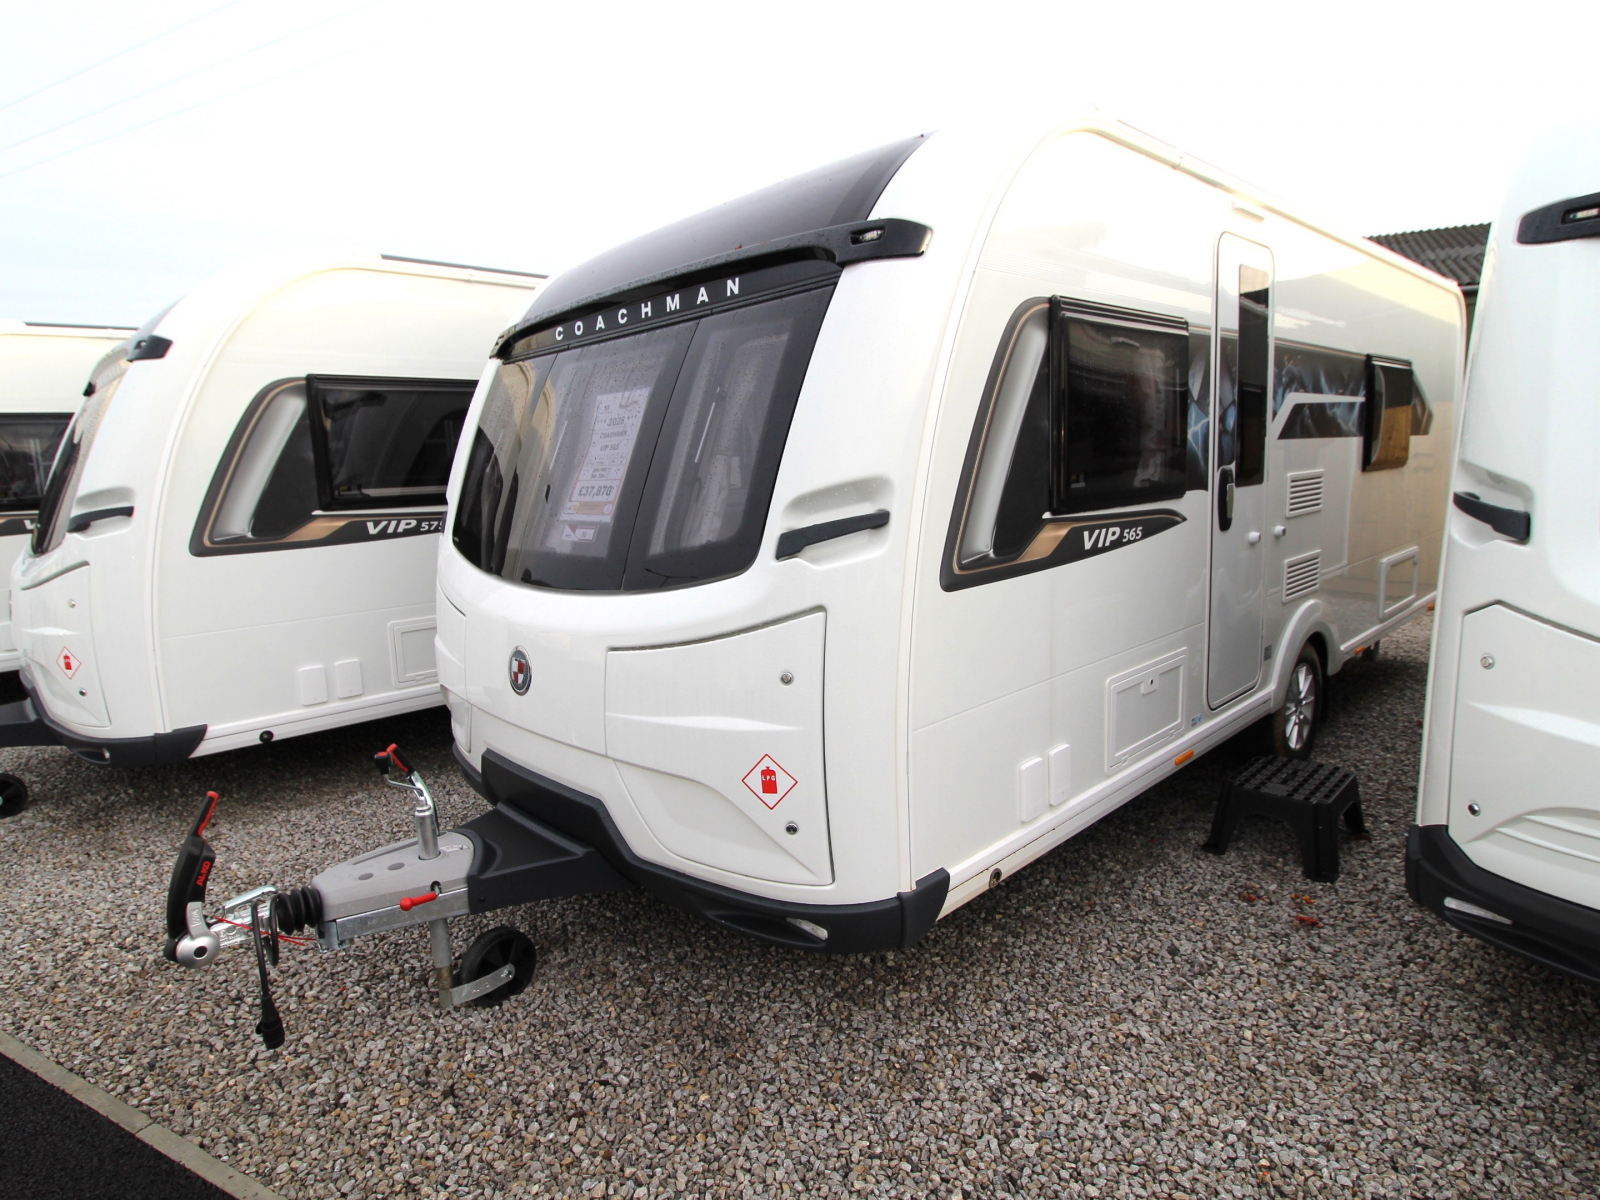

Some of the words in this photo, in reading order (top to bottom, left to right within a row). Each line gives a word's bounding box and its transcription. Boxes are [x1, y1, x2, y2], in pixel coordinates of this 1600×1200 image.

[555, 277, 740, 341] COACHMAN
[366, 520, 417, 535] VIP
[1083, 526, 1121, 550] VIP
[1122, 526, 1143, 542] 565
